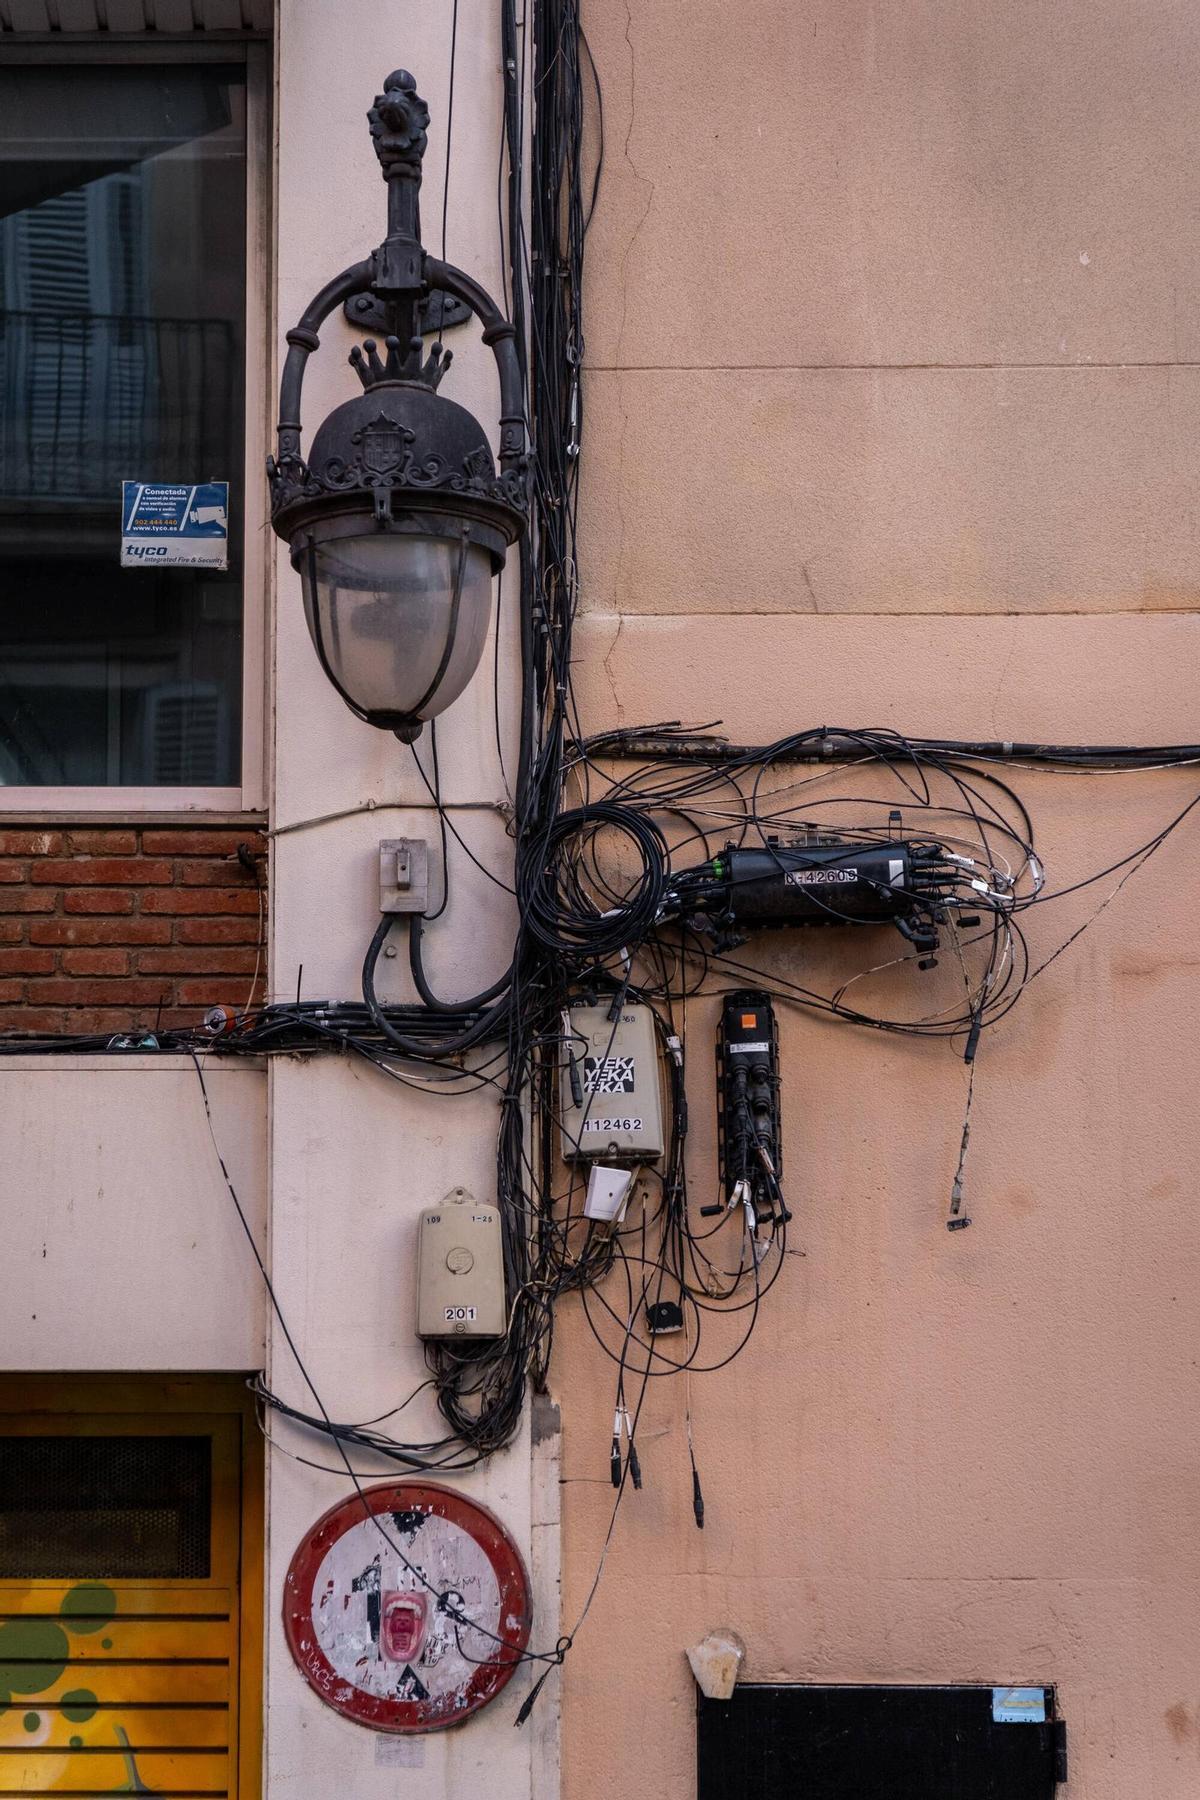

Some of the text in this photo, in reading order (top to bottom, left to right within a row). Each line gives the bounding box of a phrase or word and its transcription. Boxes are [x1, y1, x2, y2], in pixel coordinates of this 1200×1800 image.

[126, 544, 168, 558] tyco
[584, 1119, 642, 1131] 112462
[446, 1308, 476, 1320] 201
